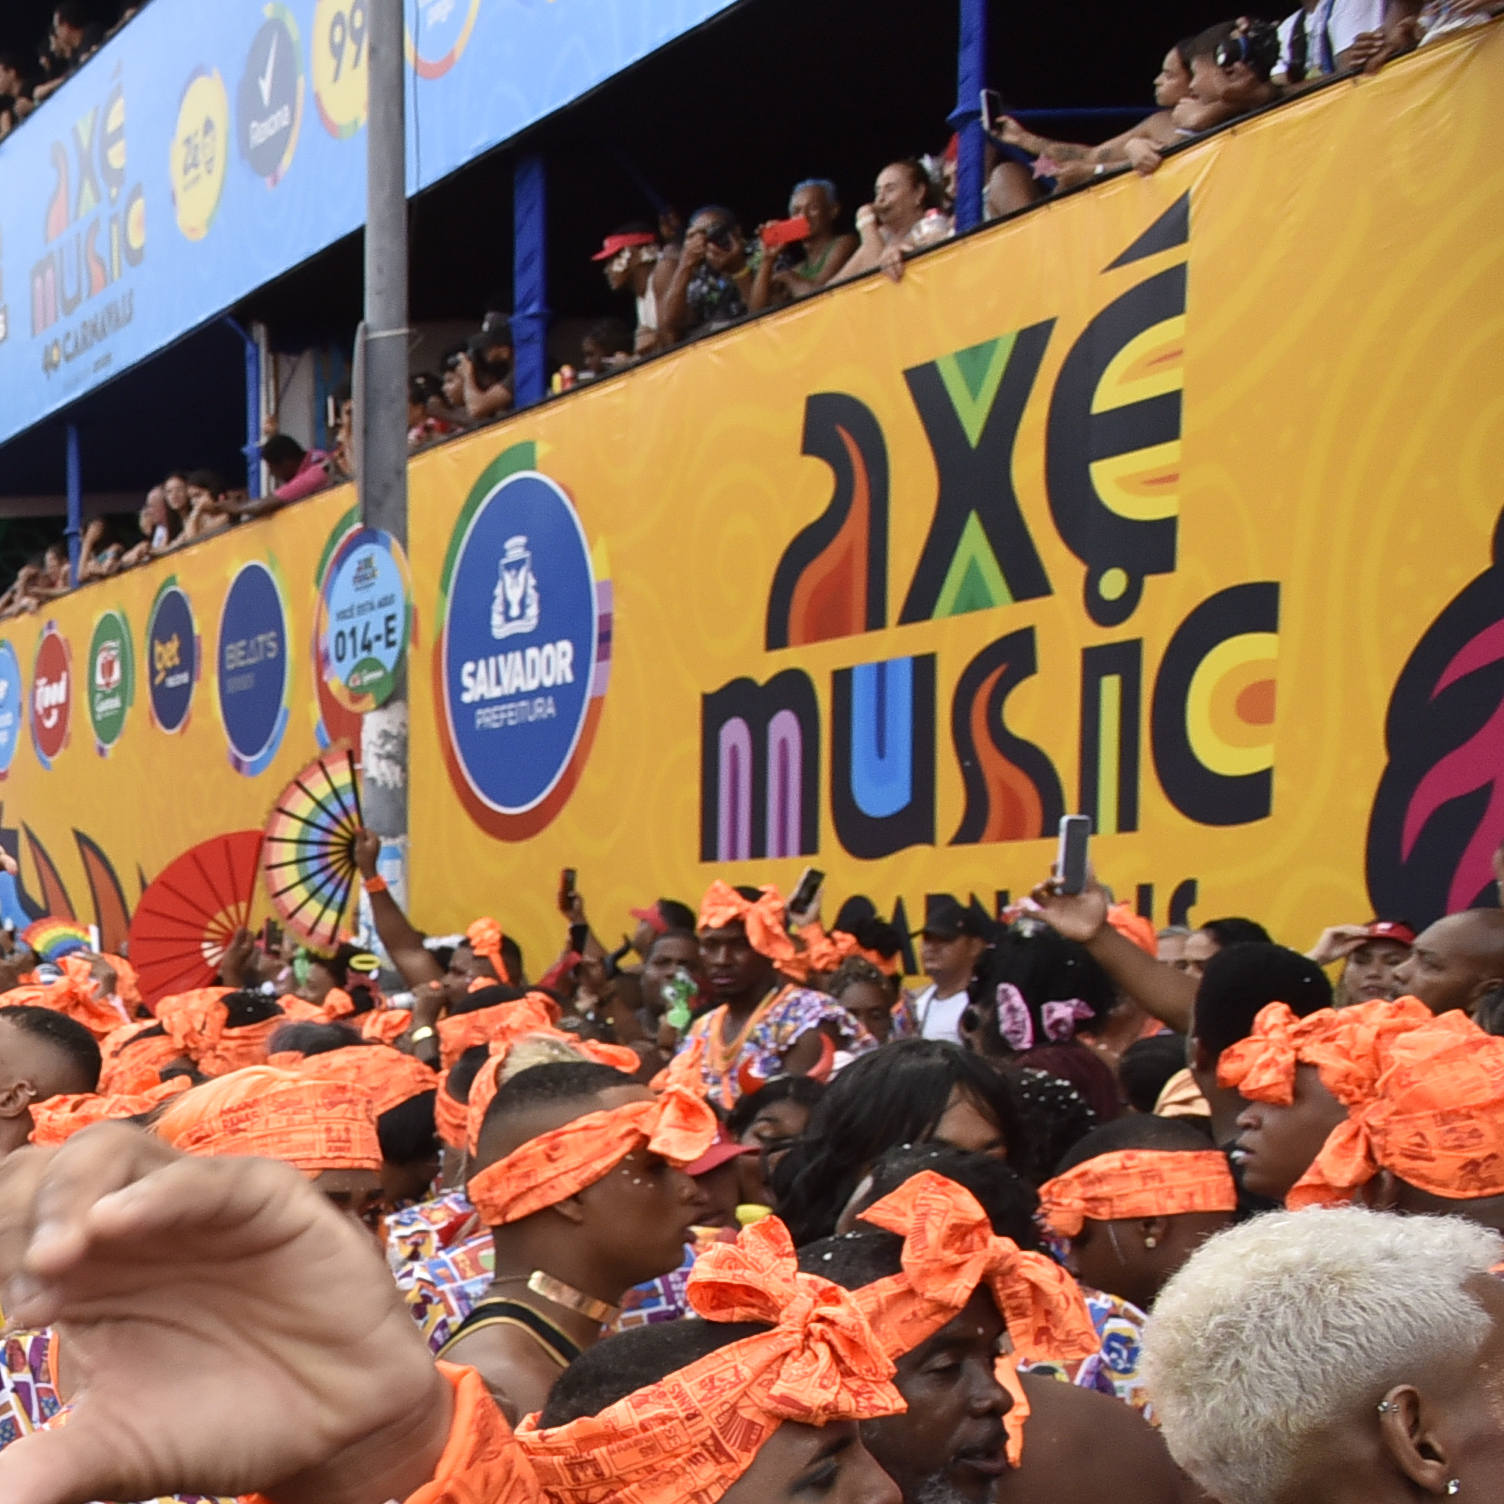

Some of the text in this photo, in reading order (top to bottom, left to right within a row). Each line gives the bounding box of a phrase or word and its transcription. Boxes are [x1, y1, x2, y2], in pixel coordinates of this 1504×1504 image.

[765, 188, 1191, 653] AXÉ
[225, 630, 279, 671] BEATS
[334, 612, 397, 664] 014-E
[460, 638, 574, 704] SALVADOR
[475, 695, 557, 731] PREFEITURA
[698, 570, 1282, 864] MUSIC
